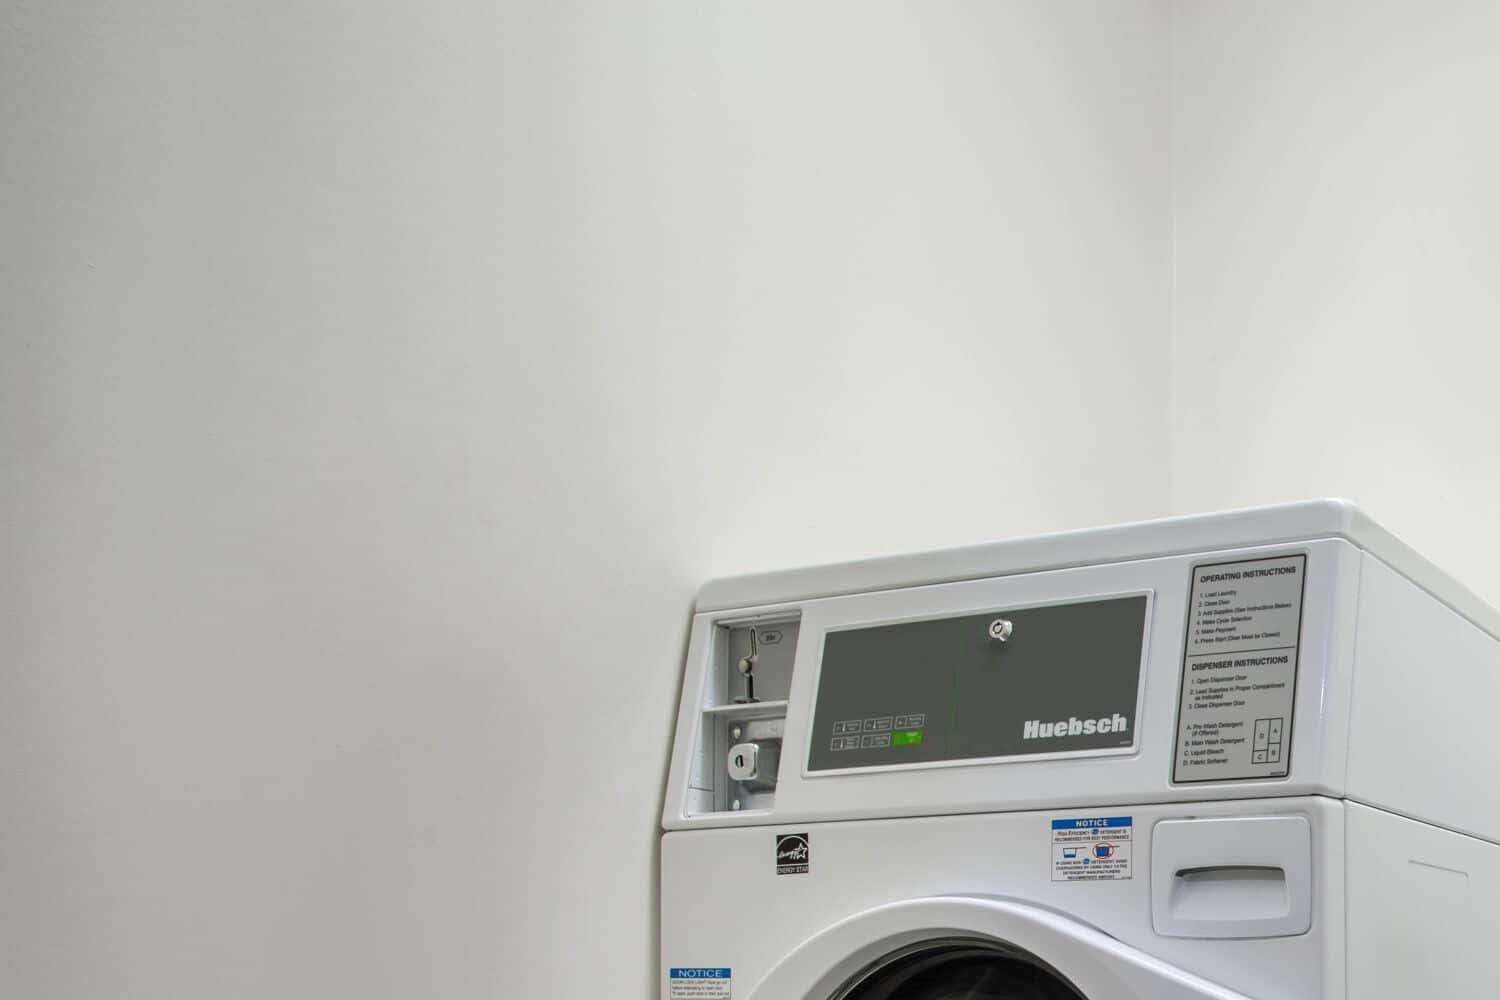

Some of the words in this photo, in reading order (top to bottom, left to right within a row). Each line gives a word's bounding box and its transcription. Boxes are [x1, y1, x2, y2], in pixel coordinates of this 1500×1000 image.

[1200, 572, 1241, 583] OPERATING
[1242, 566, 1296, 578] INSTRUCTIONS
[1191, 660, 1233, 671] DISPENSER
[1234, 656, 1288, 668] INSTRUCTIONS
[1023, 713, 1127, 739] Huebsch
[1075, 819, 1108, 827] NOTICE
[679, 969, 721, 978] NOTICE
